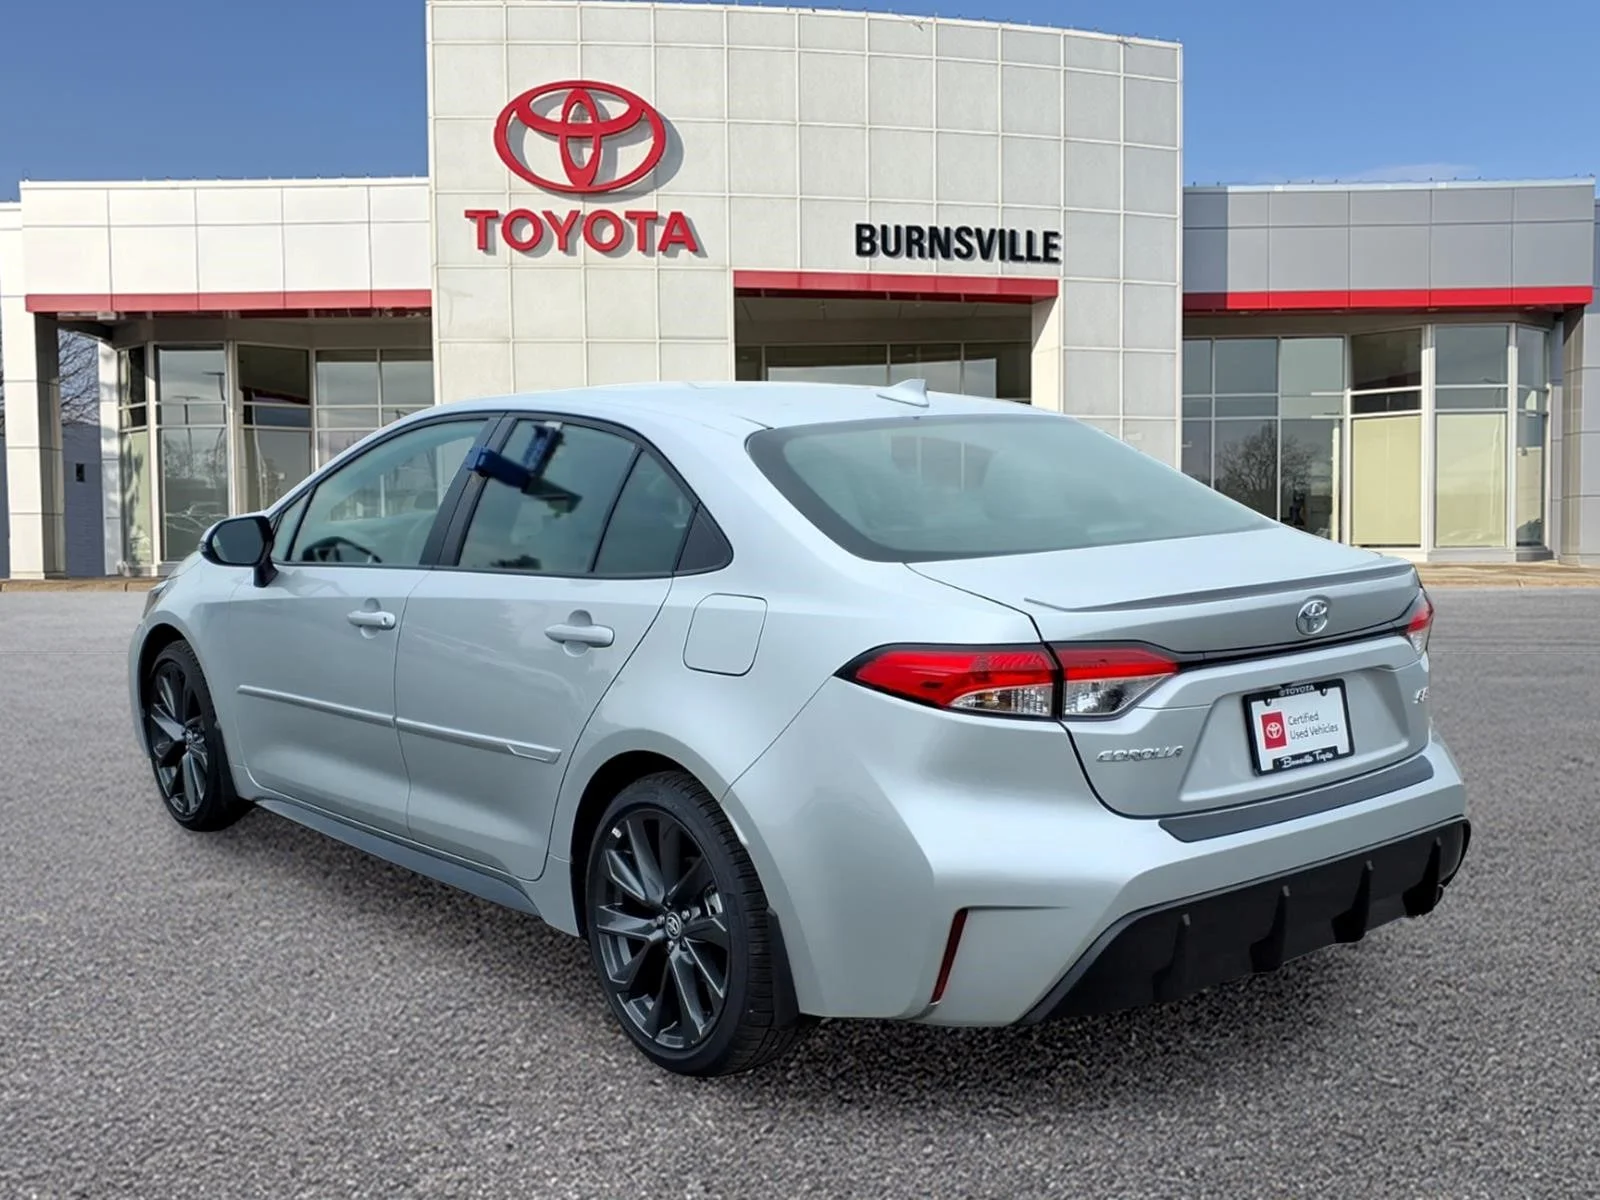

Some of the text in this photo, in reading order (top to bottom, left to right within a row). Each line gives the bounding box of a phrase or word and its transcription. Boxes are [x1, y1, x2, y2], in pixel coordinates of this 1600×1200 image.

[464, 208, 699, 253] TOYOTA
[855, 223, 1061, 263] BURNSVILLE
[1285, 684, 1315, 695] TOYOTA
[1288, 711, 1319, 725] Certified
[1290, 722, 1338, 740] Used Vehicles
[1097, 745, 1183, 762] COROLLA
